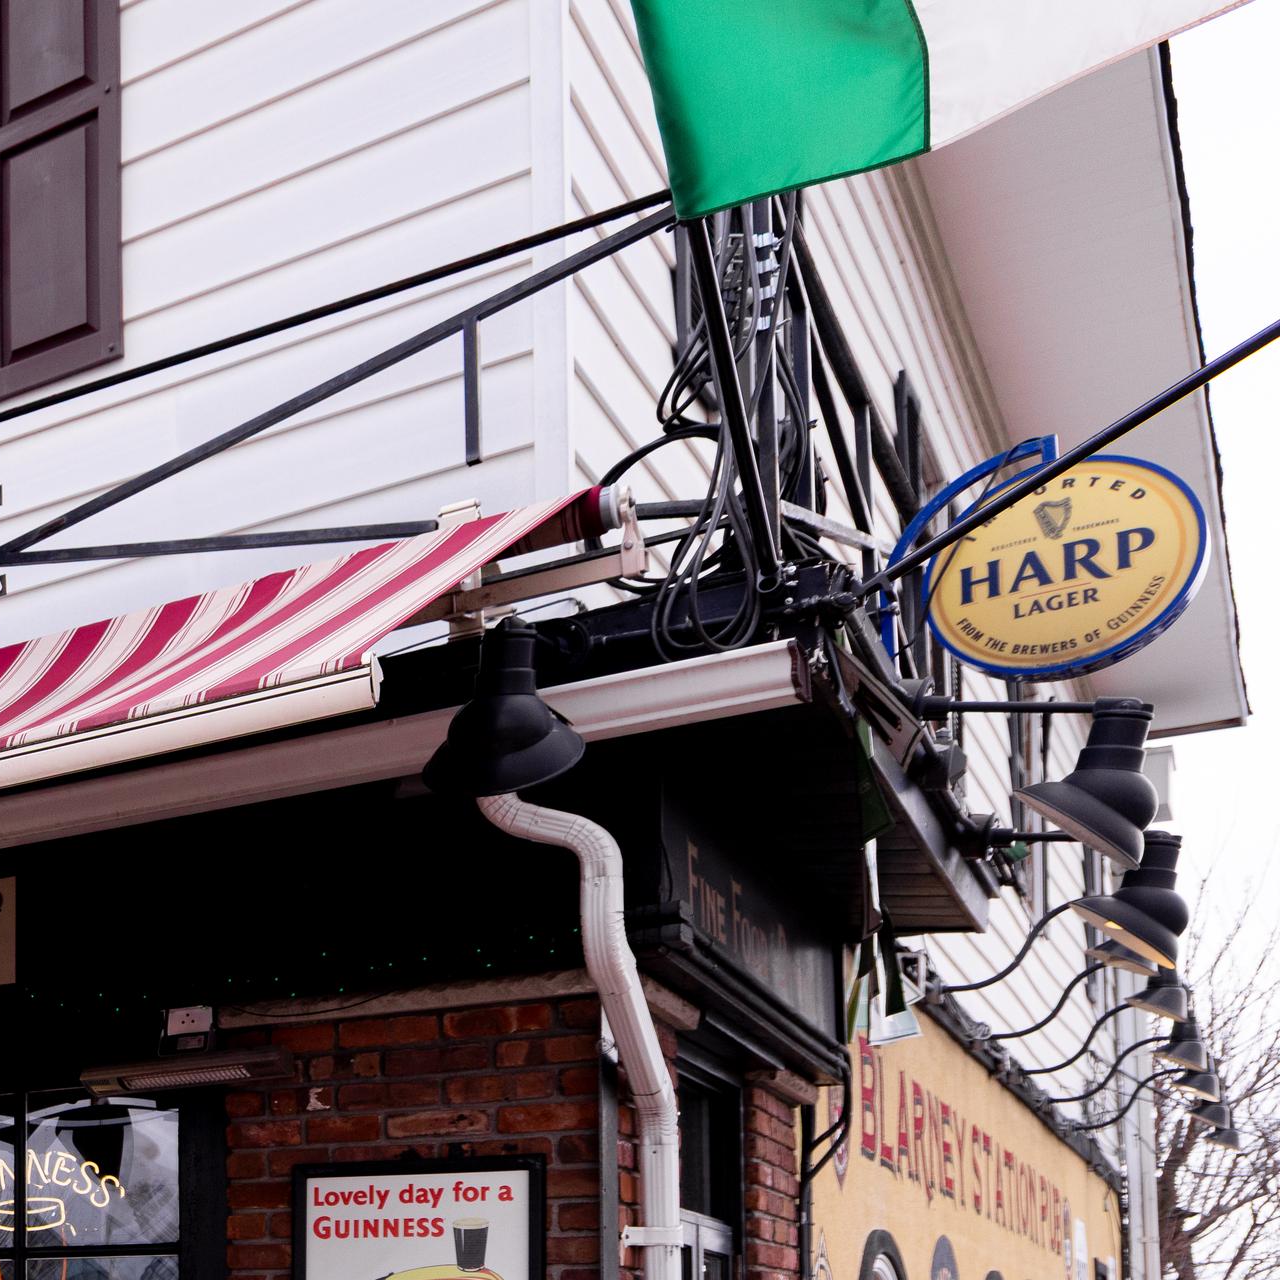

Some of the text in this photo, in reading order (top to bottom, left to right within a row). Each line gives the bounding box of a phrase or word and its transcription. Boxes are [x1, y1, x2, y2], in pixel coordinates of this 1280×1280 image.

[1072, 518, 1120, 533] TRADEMARKS
[959, 527, 1156, 606] HARP
[956, 575, 1166, 655] FROM THE BREWERS OF GUINNESS
[1013, 587, 1101, 620] LAGER
[687, 836, 727, 945] FINE
[858, 1035, 967, 1211] BLARNEY
[971, 1123, 1039, 1246] STATION
[313, 1181, 514, 1210] Lovely day for a
[312, 1215, 445, 1240] GUINNESS
